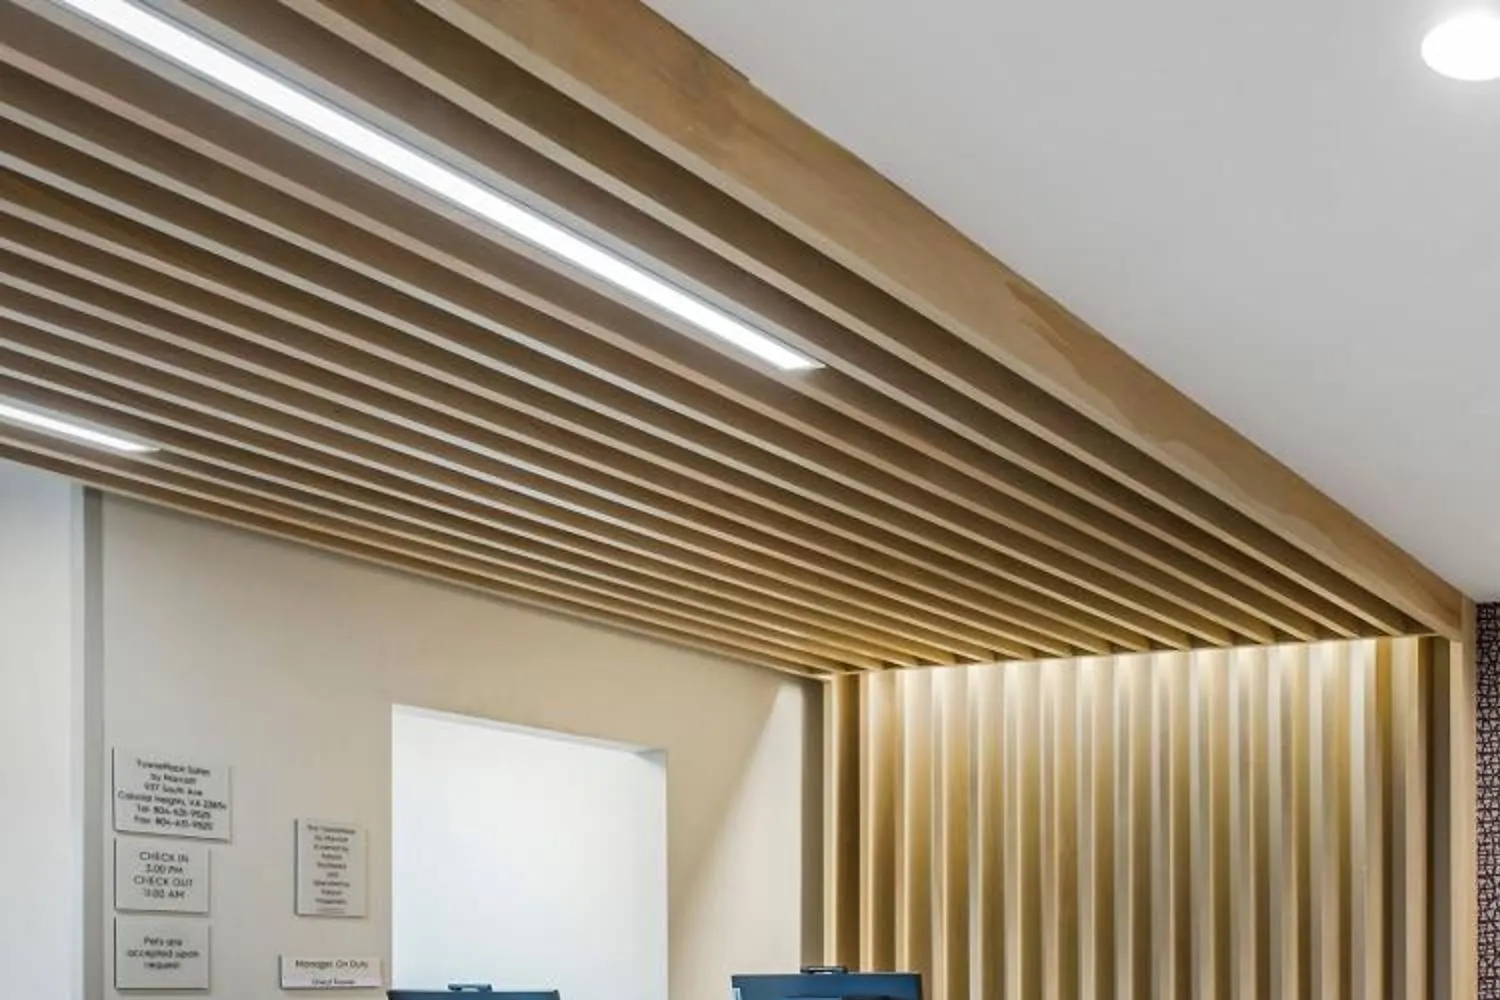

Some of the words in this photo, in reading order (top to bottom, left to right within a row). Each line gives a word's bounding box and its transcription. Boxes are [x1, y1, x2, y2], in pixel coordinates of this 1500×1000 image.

[139, 851, 175, 863] CHECK
[168, 865, 184, 875] PM
[133, 875, 169, 887] CHECK
[171, 877, 194, 888] OUT
[168, 889, 186, 899] AM
